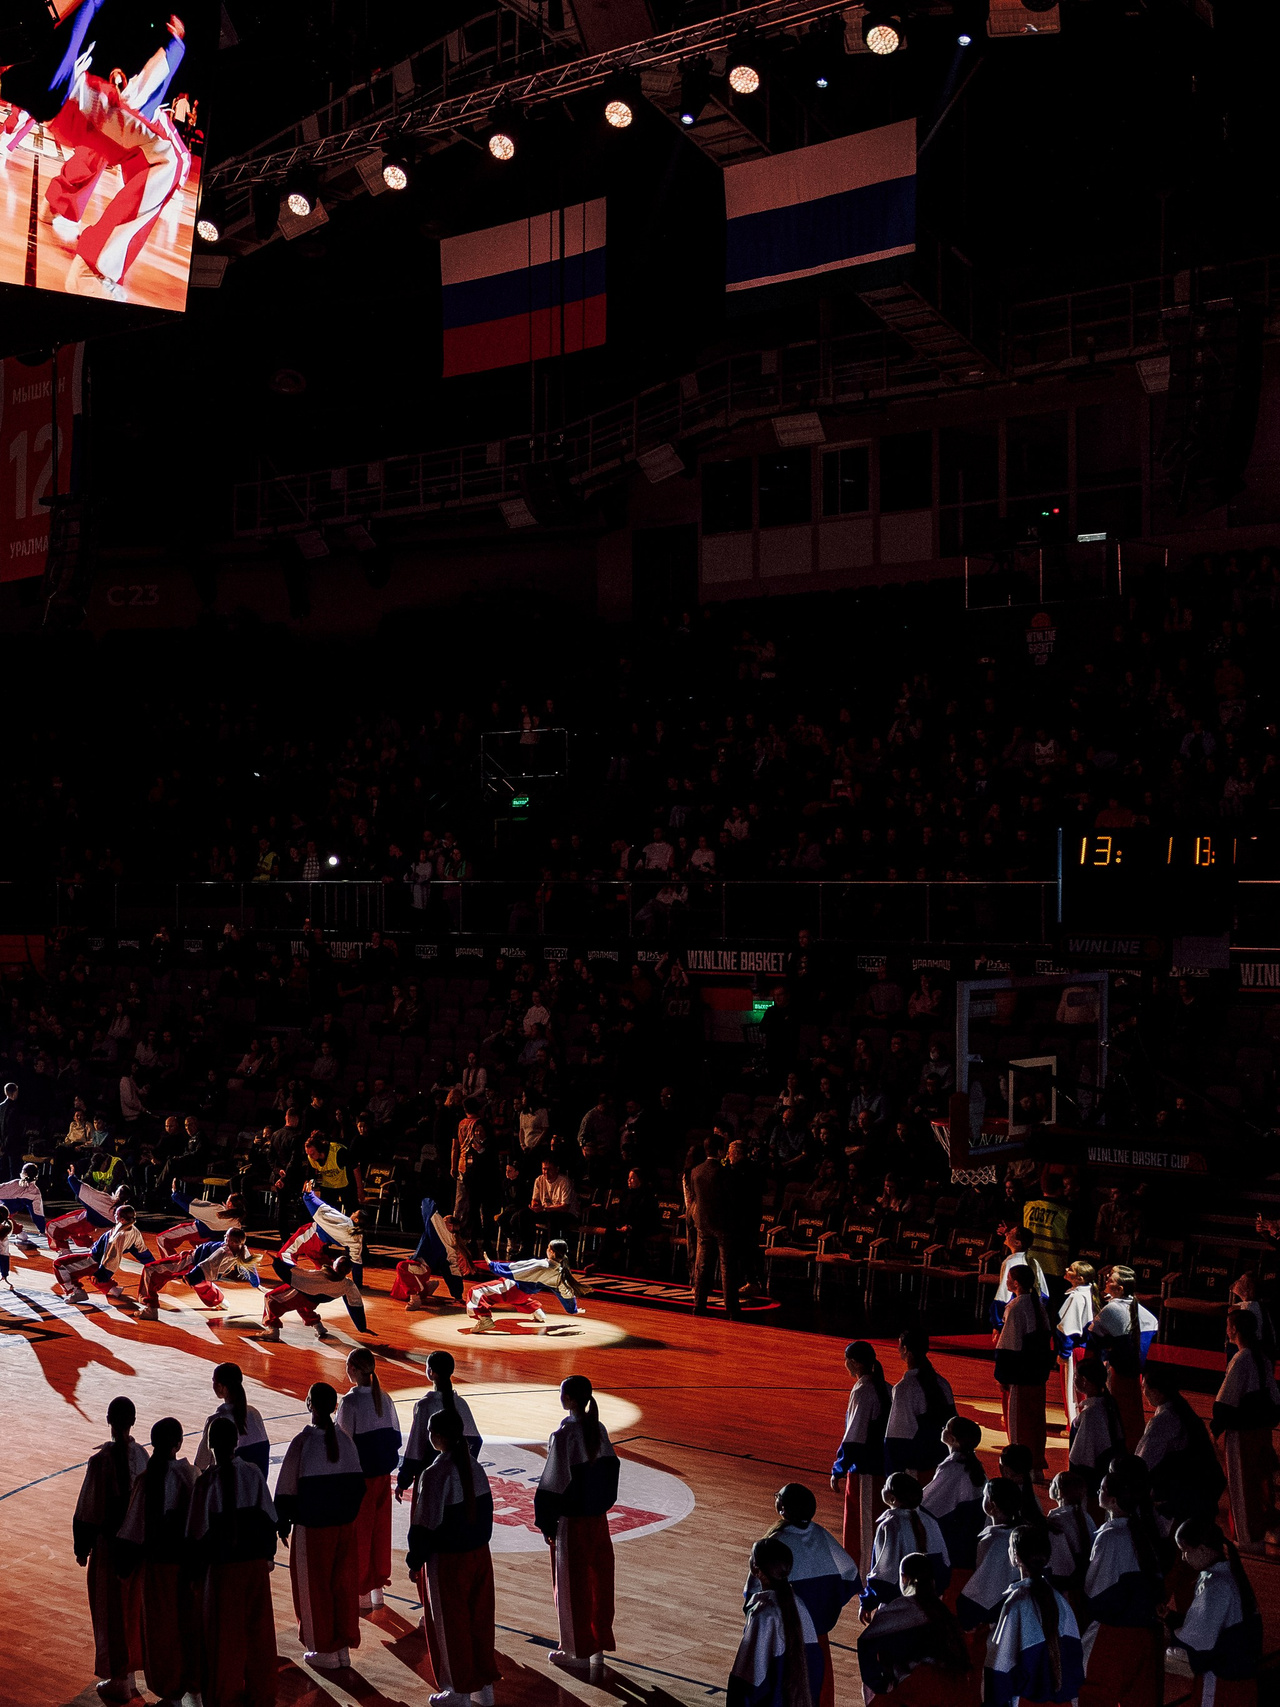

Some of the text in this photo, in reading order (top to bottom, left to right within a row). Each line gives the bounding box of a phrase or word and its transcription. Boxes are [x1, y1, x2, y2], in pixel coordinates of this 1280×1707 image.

[12, 376, 65, 405] МЫШКН
[9, 422, 63, 520] 12
[9, 535, 50, 559] УРАЛМА
[1068, 939, 1140, 955] WINLINE
[687, 949, 738, 970] WINLINE
[740, 951, 785, 973] BASKET
[1088, 1146, 1190, 1169] WINLINE BASKET CUP
[1029, 1206, 1058, 1225] 20377
